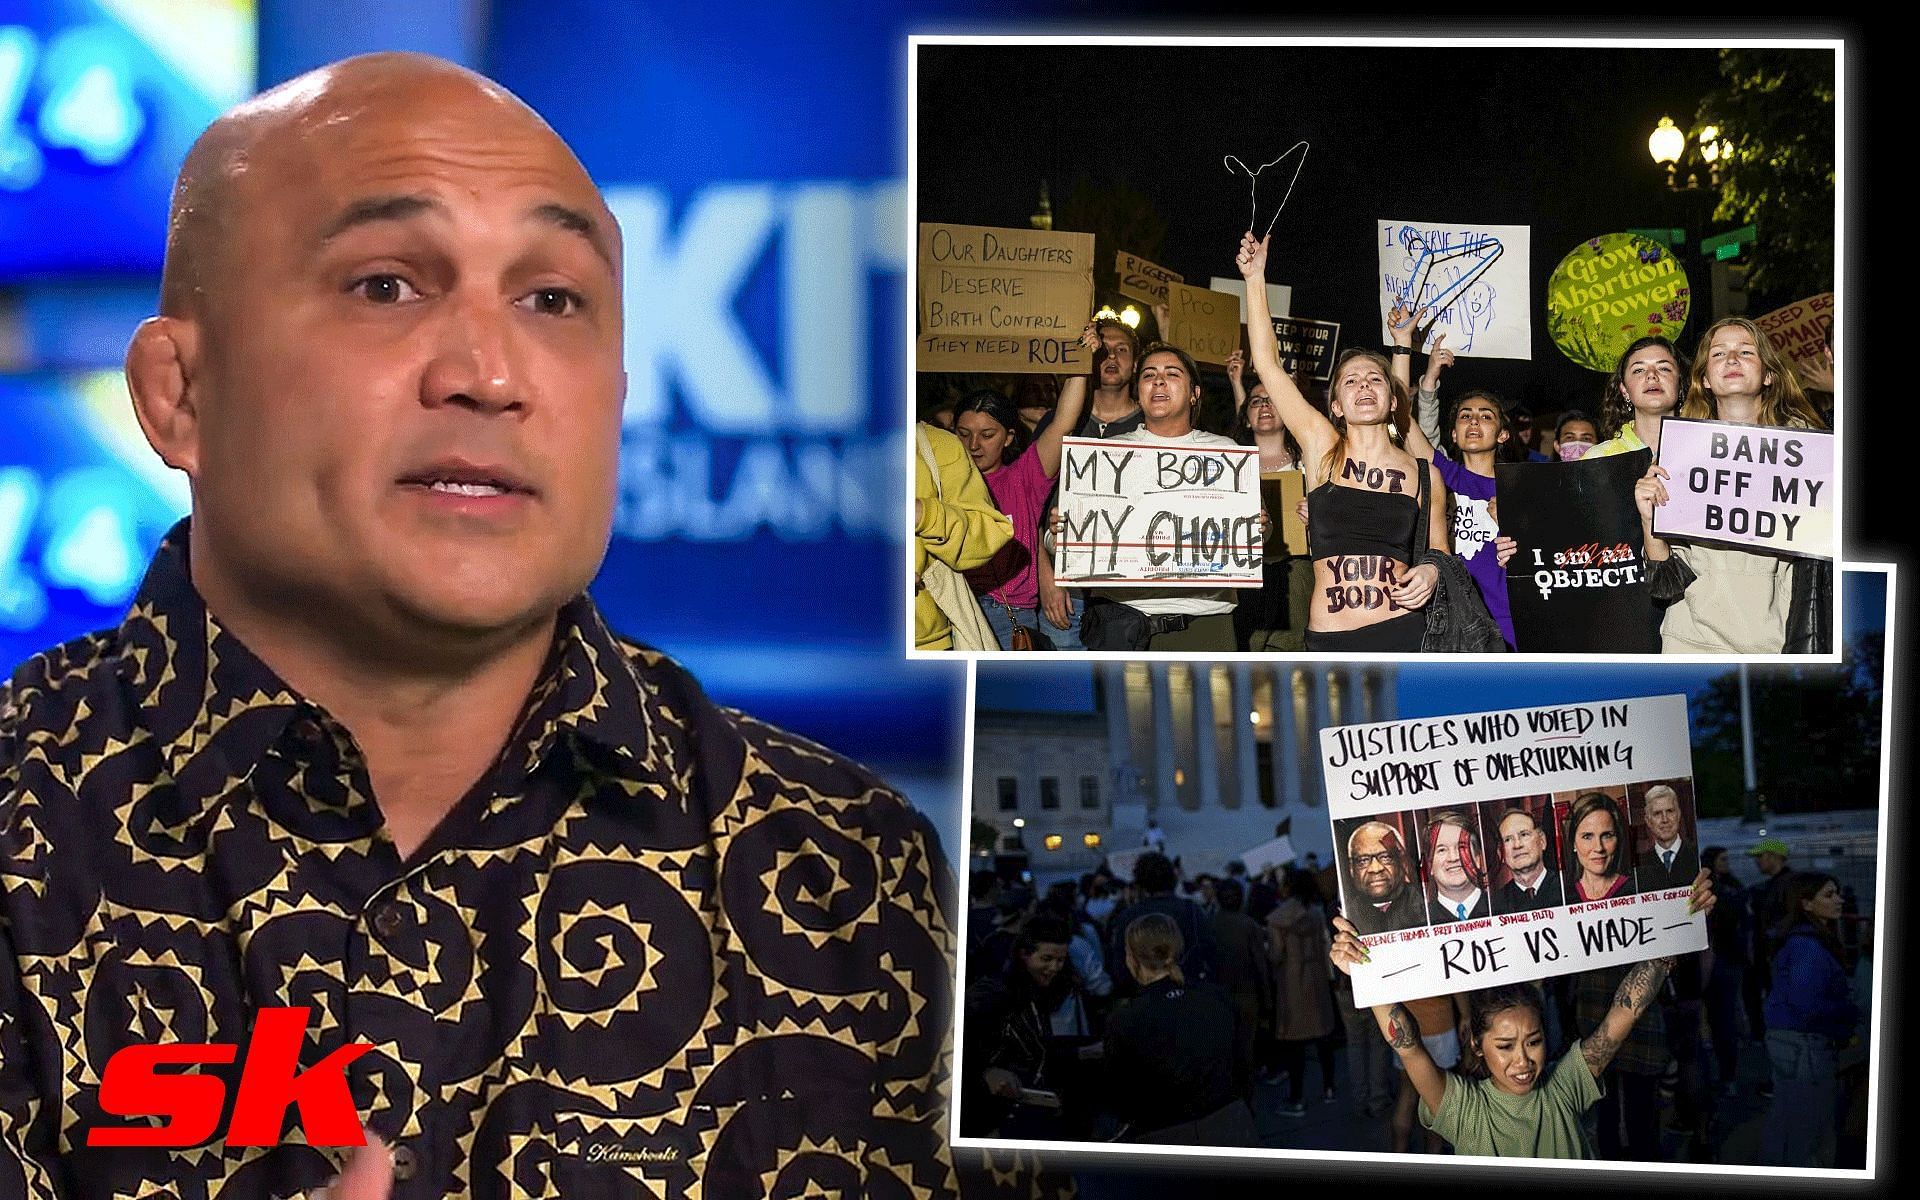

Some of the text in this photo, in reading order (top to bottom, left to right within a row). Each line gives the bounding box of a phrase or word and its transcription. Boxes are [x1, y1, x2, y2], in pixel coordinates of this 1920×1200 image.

[932, 229, 1073, 265] OUR DAUGHTERS
[1384, 226, 1489, 260] I RESERVE THE
[1567, 241, 1641, 284] Grow
[940, 269, 1025, 297] DESERVE
[1123, 273, 1169, 300] COUR
[1423, 283, 1440, 302] TO
[1549, 258, 1677, 312] Abortion
[930, 301, 1067, 329] BIRTH CONTROL
[1180, 288, 1215, 316] Pro
[1582, 278, 1682, 325] Power
[1760, 306, 1804, 332] SSED
[925, 337, 1081, 365] THEY NEED ROE
[1302, 326, 1329, 341] YOUR
[1305, 343, 1325, 357] OFF
[1290, 358, 1321, 371] BODY
[1710, 432, 1804, 468] BANS
[1065, 448, 1252, 494] MY BODY
[1341, 457, 1406, 493] NOT
[1688, 467, 1825, 508] OFF MY
[1705, 503, 1801, 542] BODY
[1061, 504, 1263, 577] MY CHOICE
[1532, 549, 1545, 566] I
[1326, 555, 1398, 586] YOUR
[1326, 585, 1401, 614] BODY
[1329, 704, 1629, 768] JUSTICES WHO VOTED IN
[1350, 740, 1634, 801] SUPPORT OF OVERTURNING
[1398, 928, 1431, 942] THOMAS
[1499, 913, 1530, 927] SAMUEL
[1568, 904, 1585, 915] AMY
[1586, 900, 1609, 911] CONEY
[1640, 892, 1661, 905] NEIL
[1439, 917, 1657, 980] ROE VS. WADE
